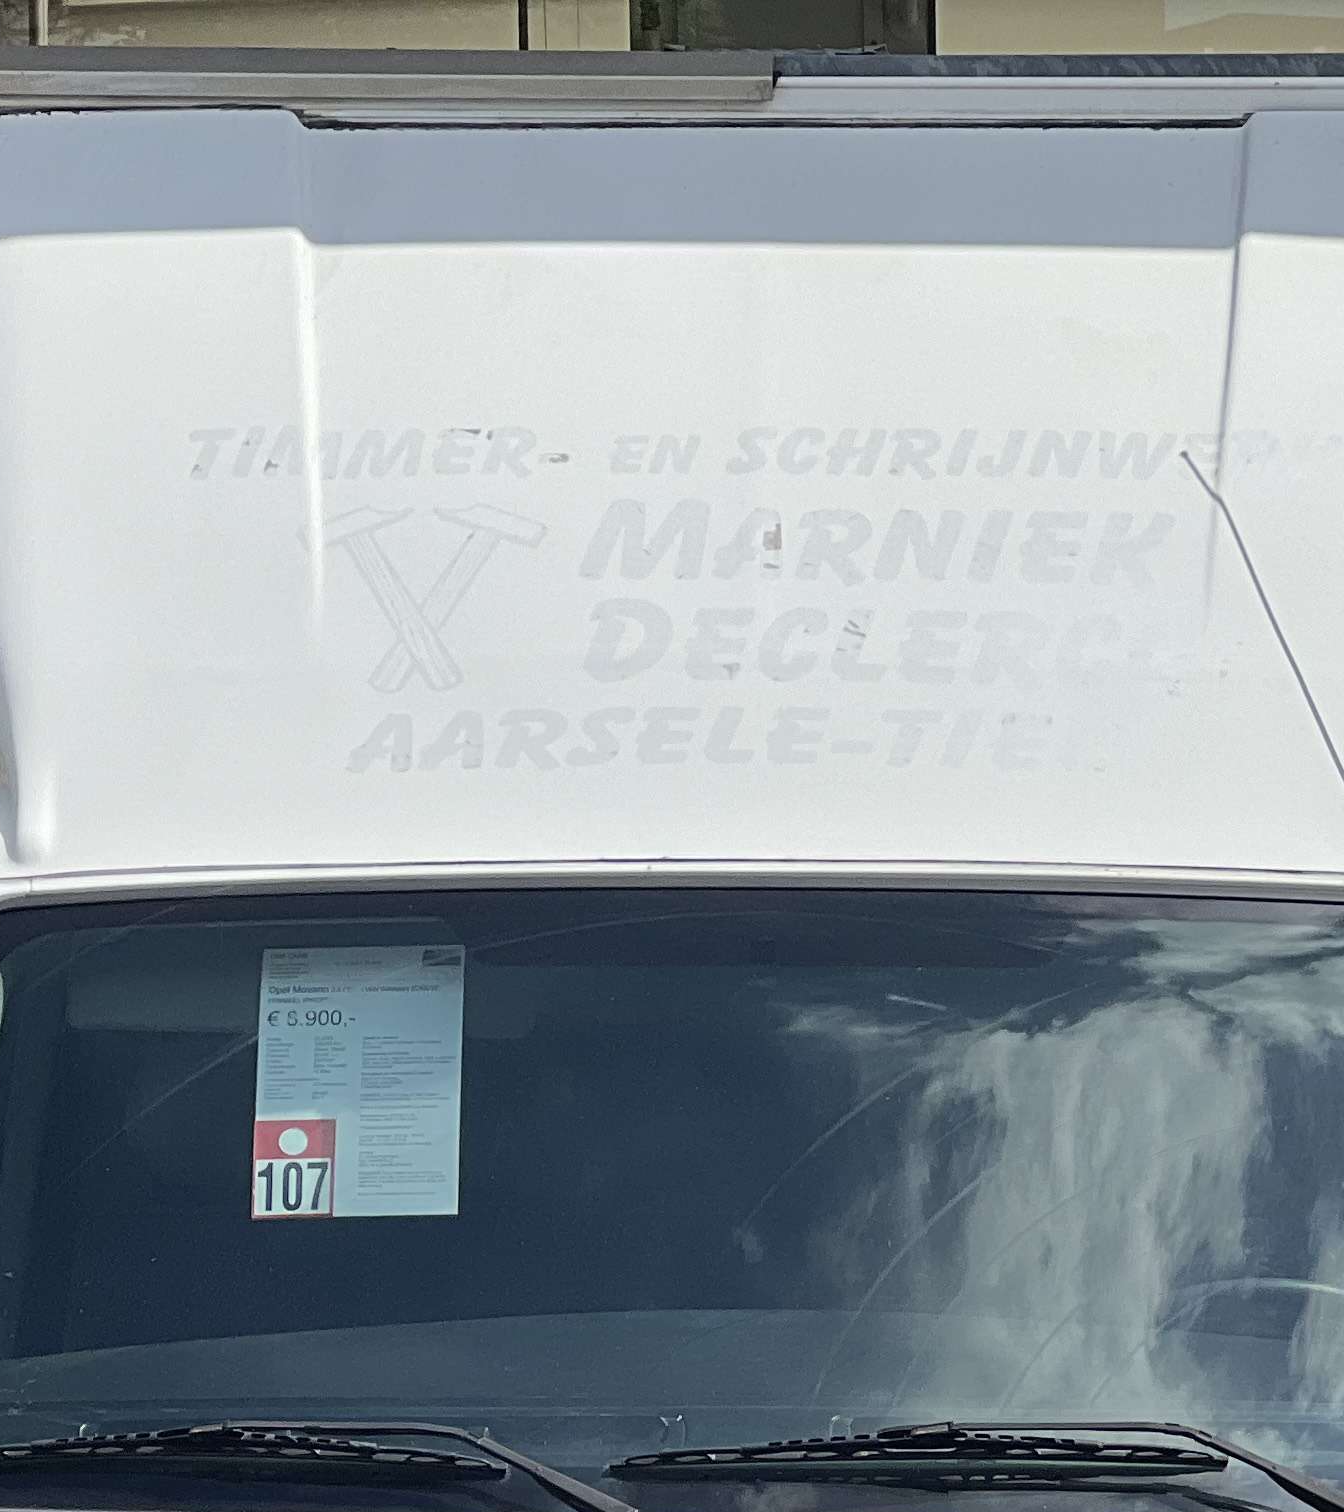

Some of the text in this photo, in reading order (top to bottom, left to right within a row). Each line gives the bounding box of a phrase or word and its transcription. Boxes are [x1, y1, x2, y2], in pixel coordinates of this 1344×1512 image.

[610, 434, 698, 476] EN
[578, 499, 1177, 586] MARNIEK
[267, 1010, 281, 1027] €
[257, 1161, 329, 1212] 107
